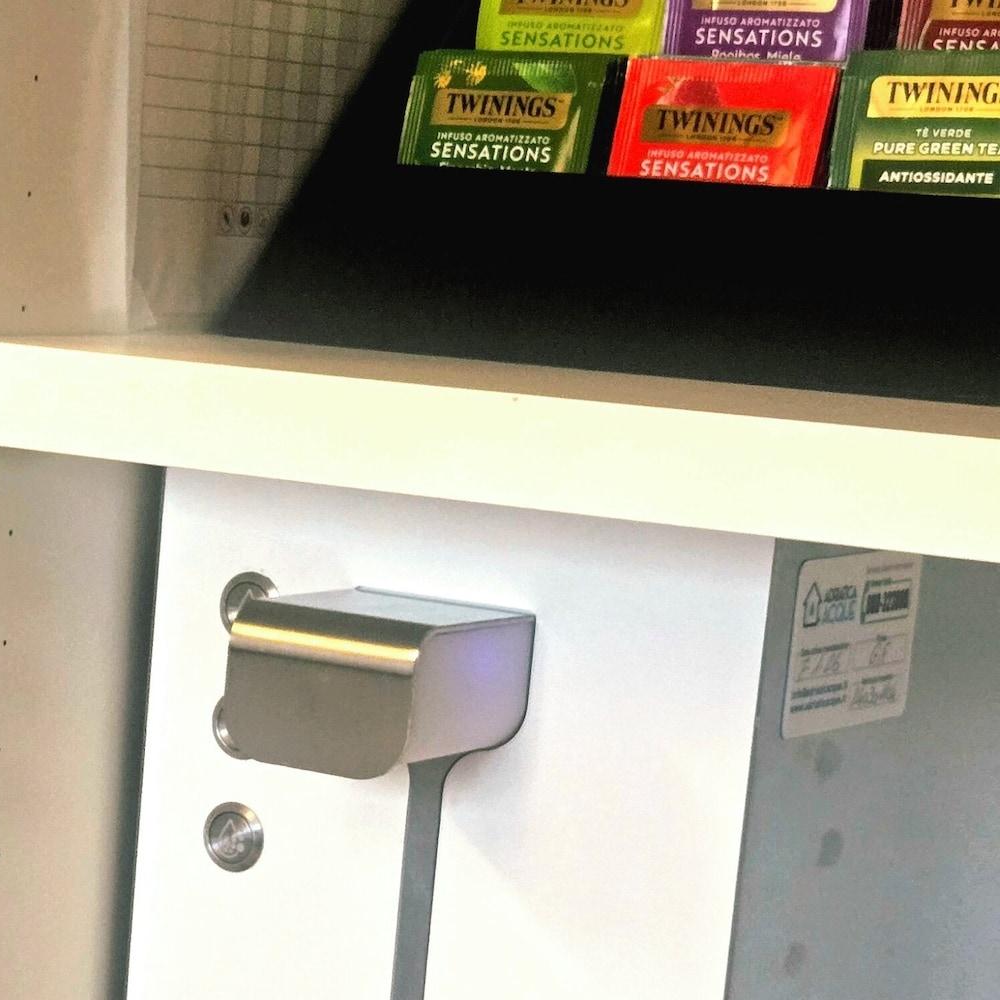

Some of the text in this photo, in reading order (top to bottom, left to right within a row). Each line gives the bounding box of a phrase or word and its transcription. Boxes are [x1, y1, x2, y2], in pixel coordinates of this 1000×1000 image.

[507, 21, 624, 31] INFUSO AROMATIZZATO
[701, 16, 820, 28] INFUSO AROMATIZZATO
[695, 28, 823, 48] SENSATIONS
[939, 27, 980, 37] INFUSO
[500, 30, 624, 50] SENSATIONS
[887, 81, 1000, 105] TWINING
[447, 92, 557, 117] TWININGS
[657, 108, 776, 136] TWININGS
[437, 131, 551, 145] INFUSO AROMATIZZATO
[932, 128, 972, 138] VERDE
[430, 141, 552, 163] SENSATIONS
[873, 141, 916, 155] PURE
[918, 142, 974, 155] GREEN
[647, 149, 769, 163] INFUSO AROMATIZZATO
[639, 159, 770, 183] SENSATIONS
[878, 170, 995, 184] ANTIOSSIDANTE
